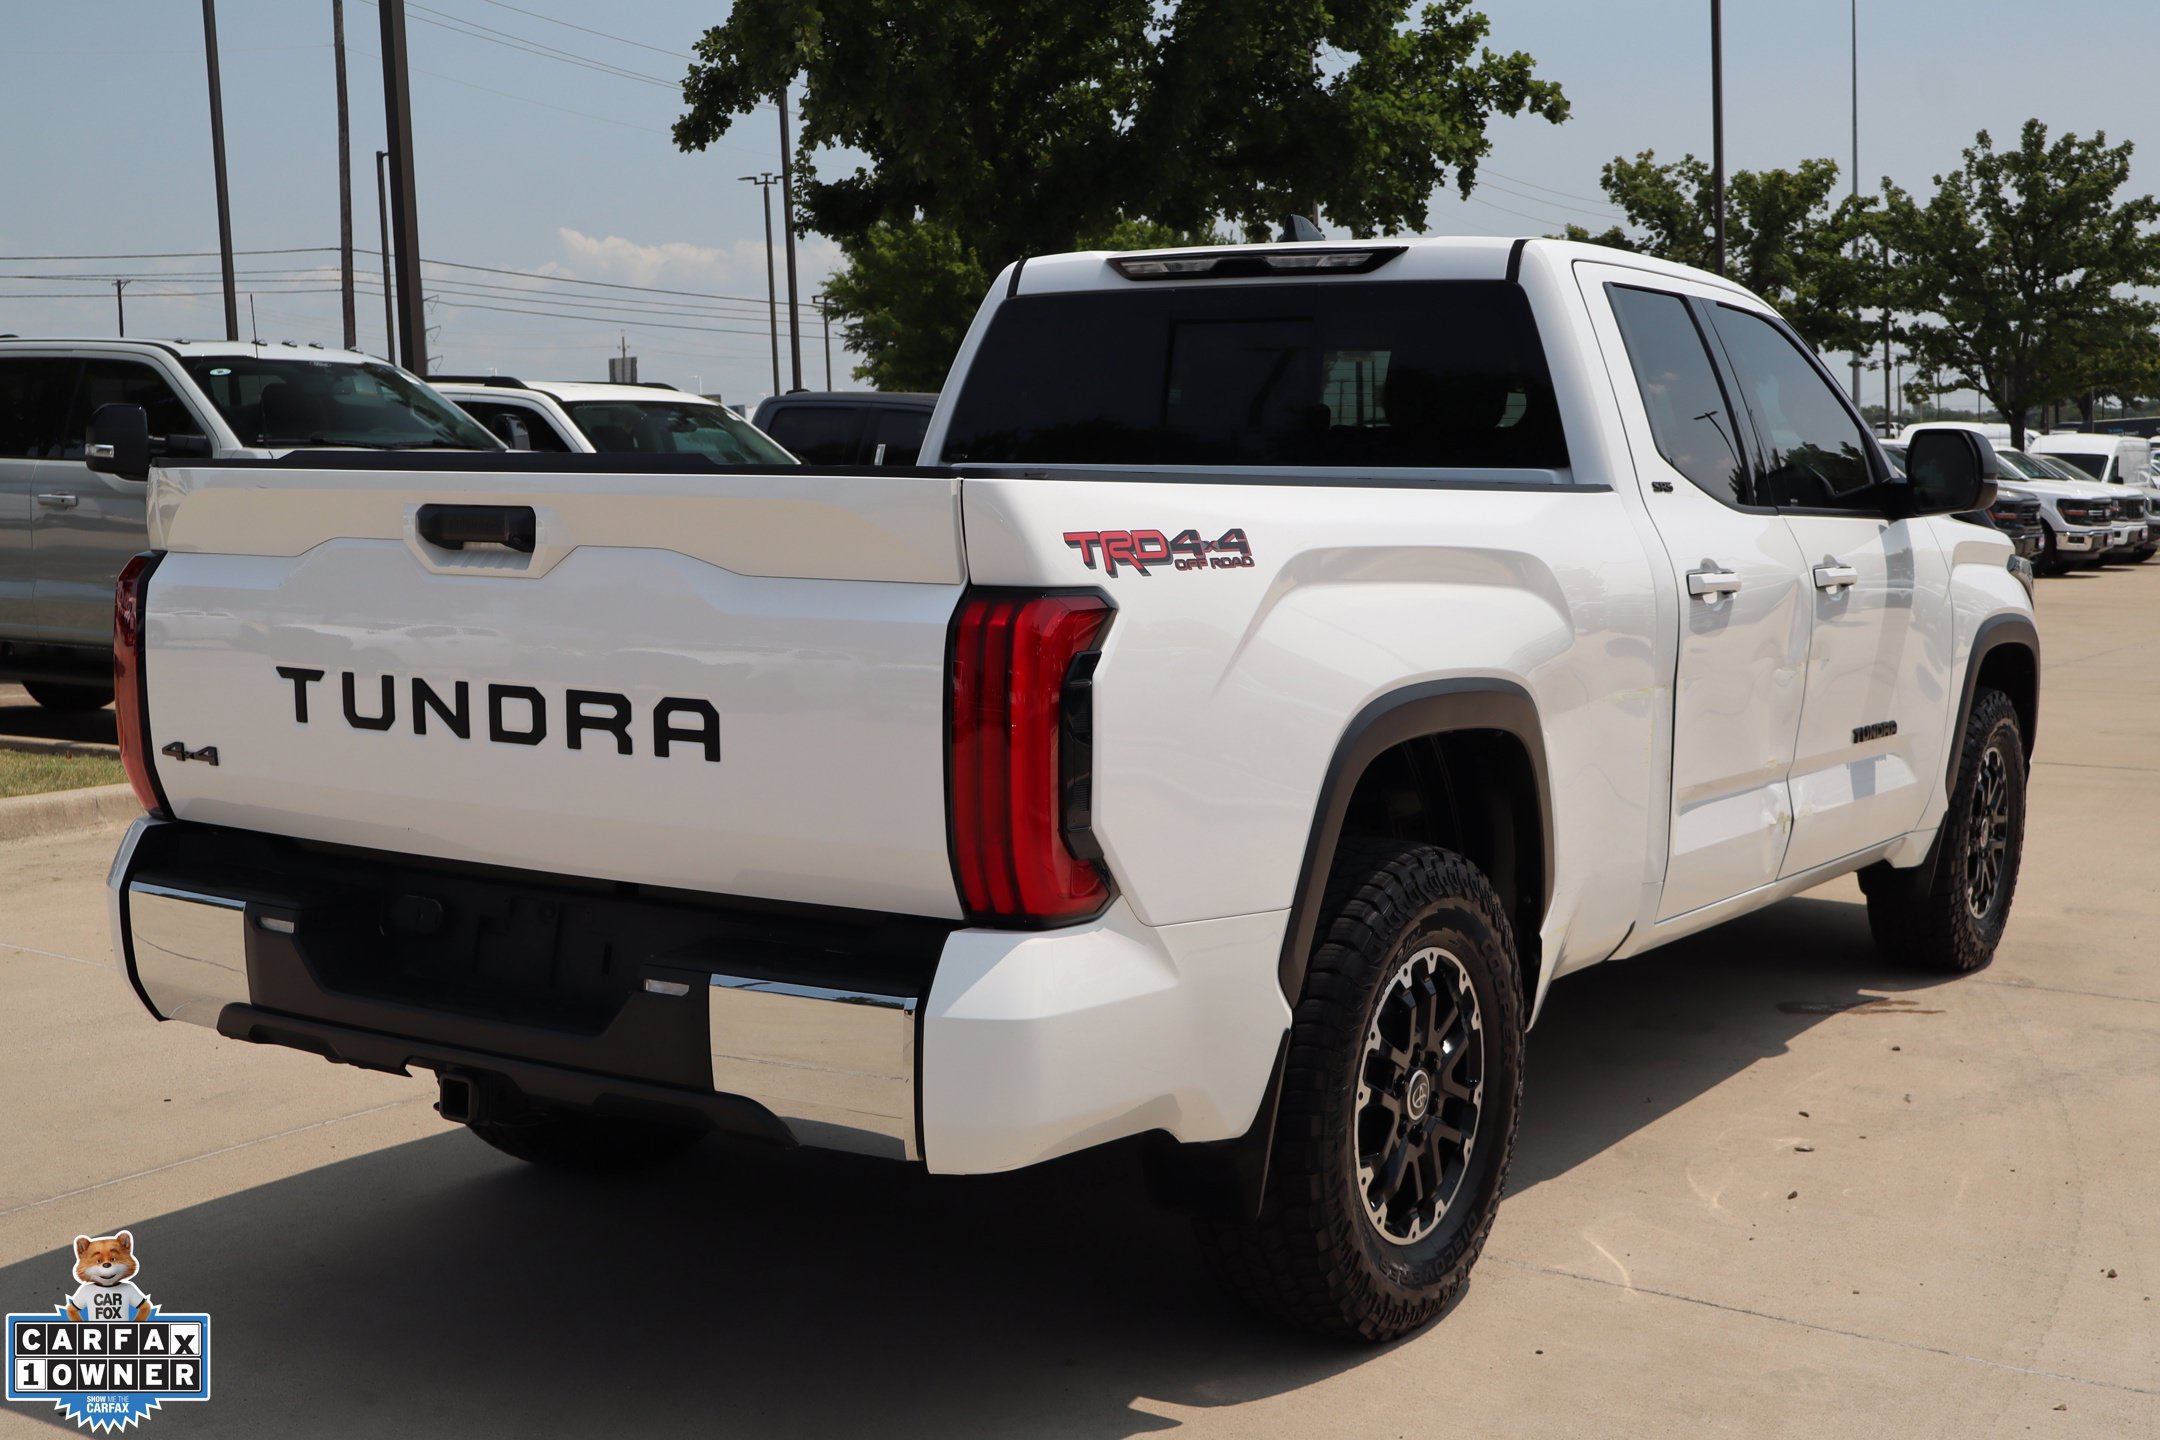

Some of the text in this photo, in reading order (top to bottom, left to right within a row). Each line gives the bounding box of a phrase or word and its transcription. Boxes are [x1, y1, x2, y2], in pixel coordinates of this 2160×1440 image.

[1063, 529, 1173, 578] TRD
[1175, 556, 1255, 571] OFF ROAD
[275, 665, 721, 762] TUNDRA
[1852, 719, 1898, 744] TUNDRA
[1480, 938, 1515, 1069] COOPER
